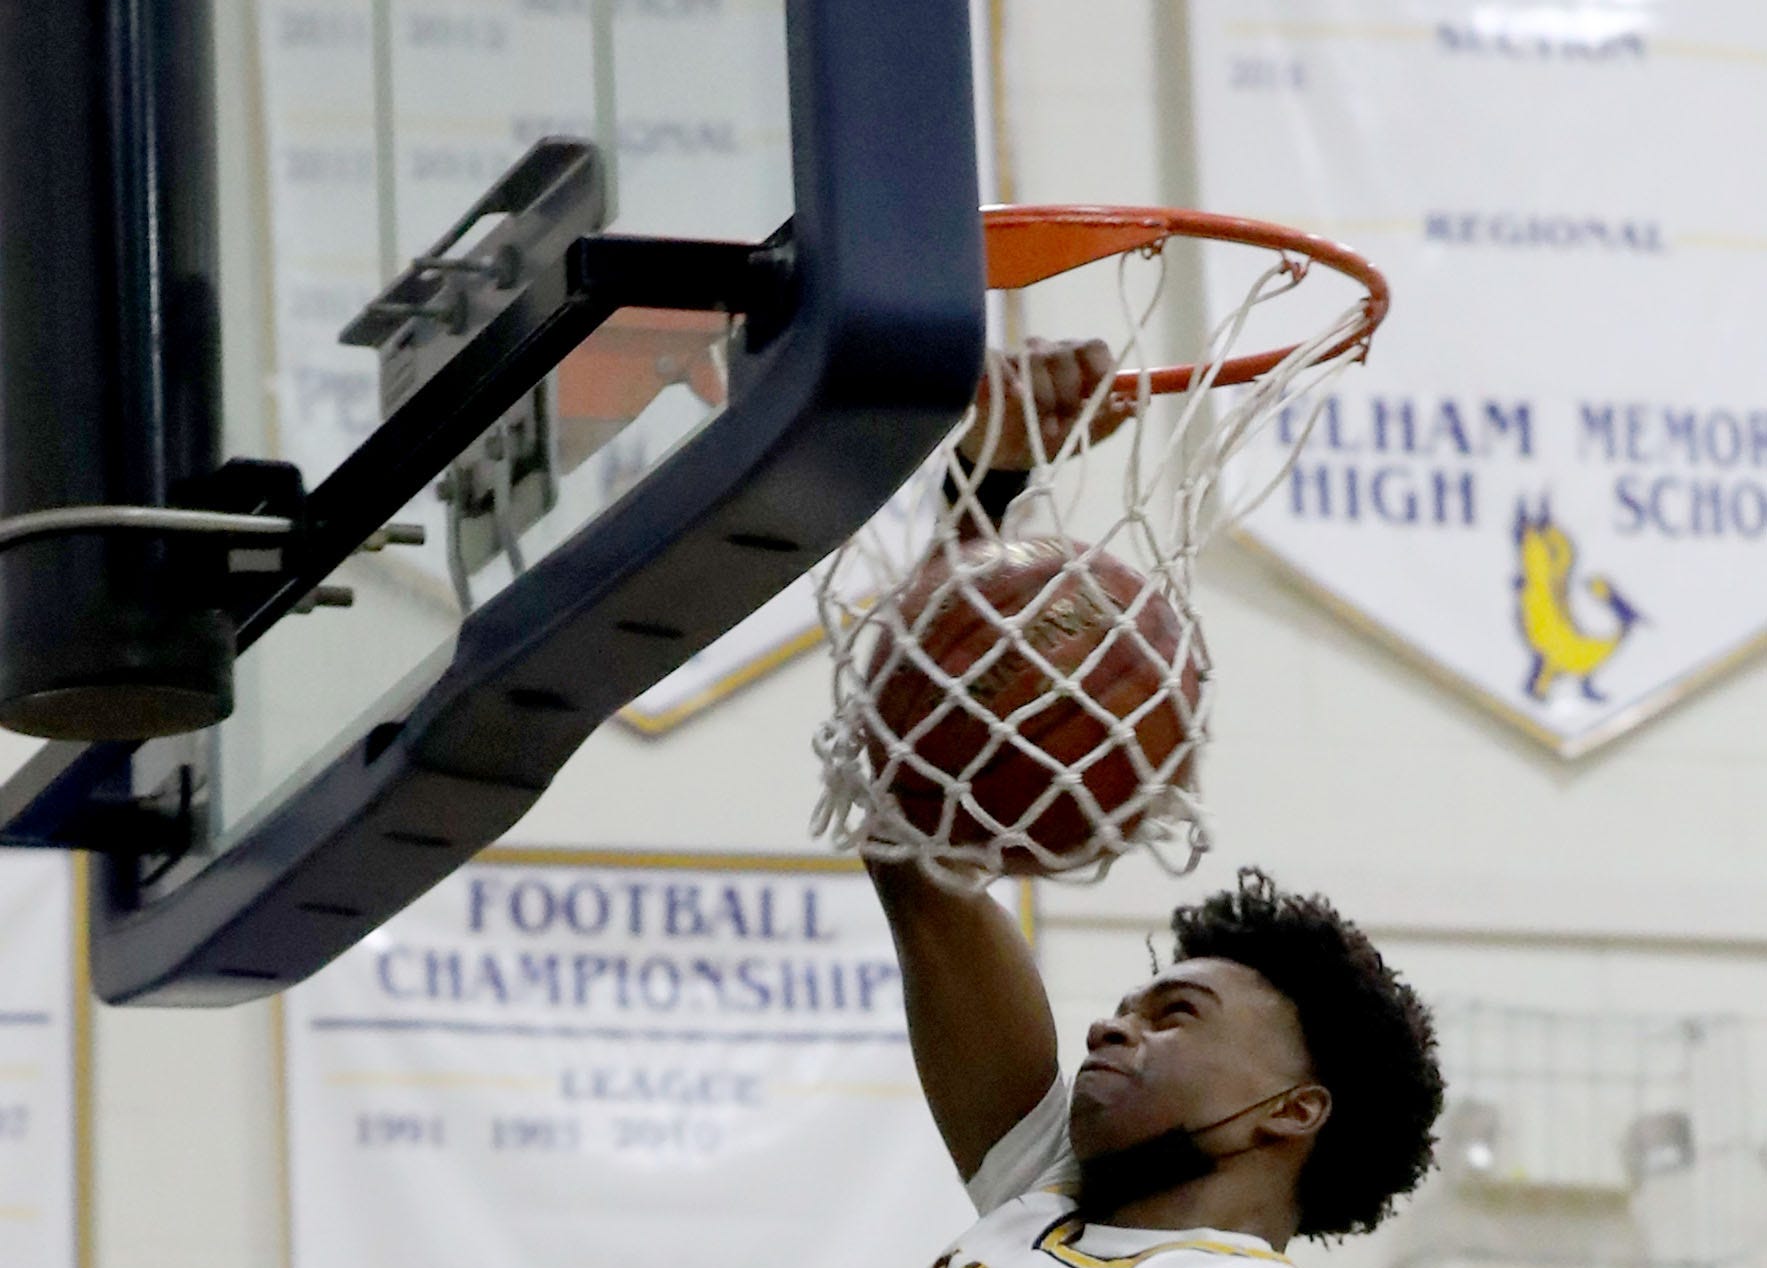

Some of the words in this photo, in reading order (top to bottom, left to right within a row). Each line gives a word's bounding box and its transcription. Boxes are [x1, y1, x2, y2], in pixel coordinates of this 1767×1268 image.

[1424, 211, 1666, 253] REGIONAL
[1235, 388, 1534, 458] ELHAM
[1288, 462, 1477, 527] HIGH
[1612, 472, 1767, 540] SCHO
[466, 877, 838, 941] FOOTBALL
[375, 943, 904, 1012] CHAMPIONSHIP
[559, 1065, 764, 1108] LEAGUE
